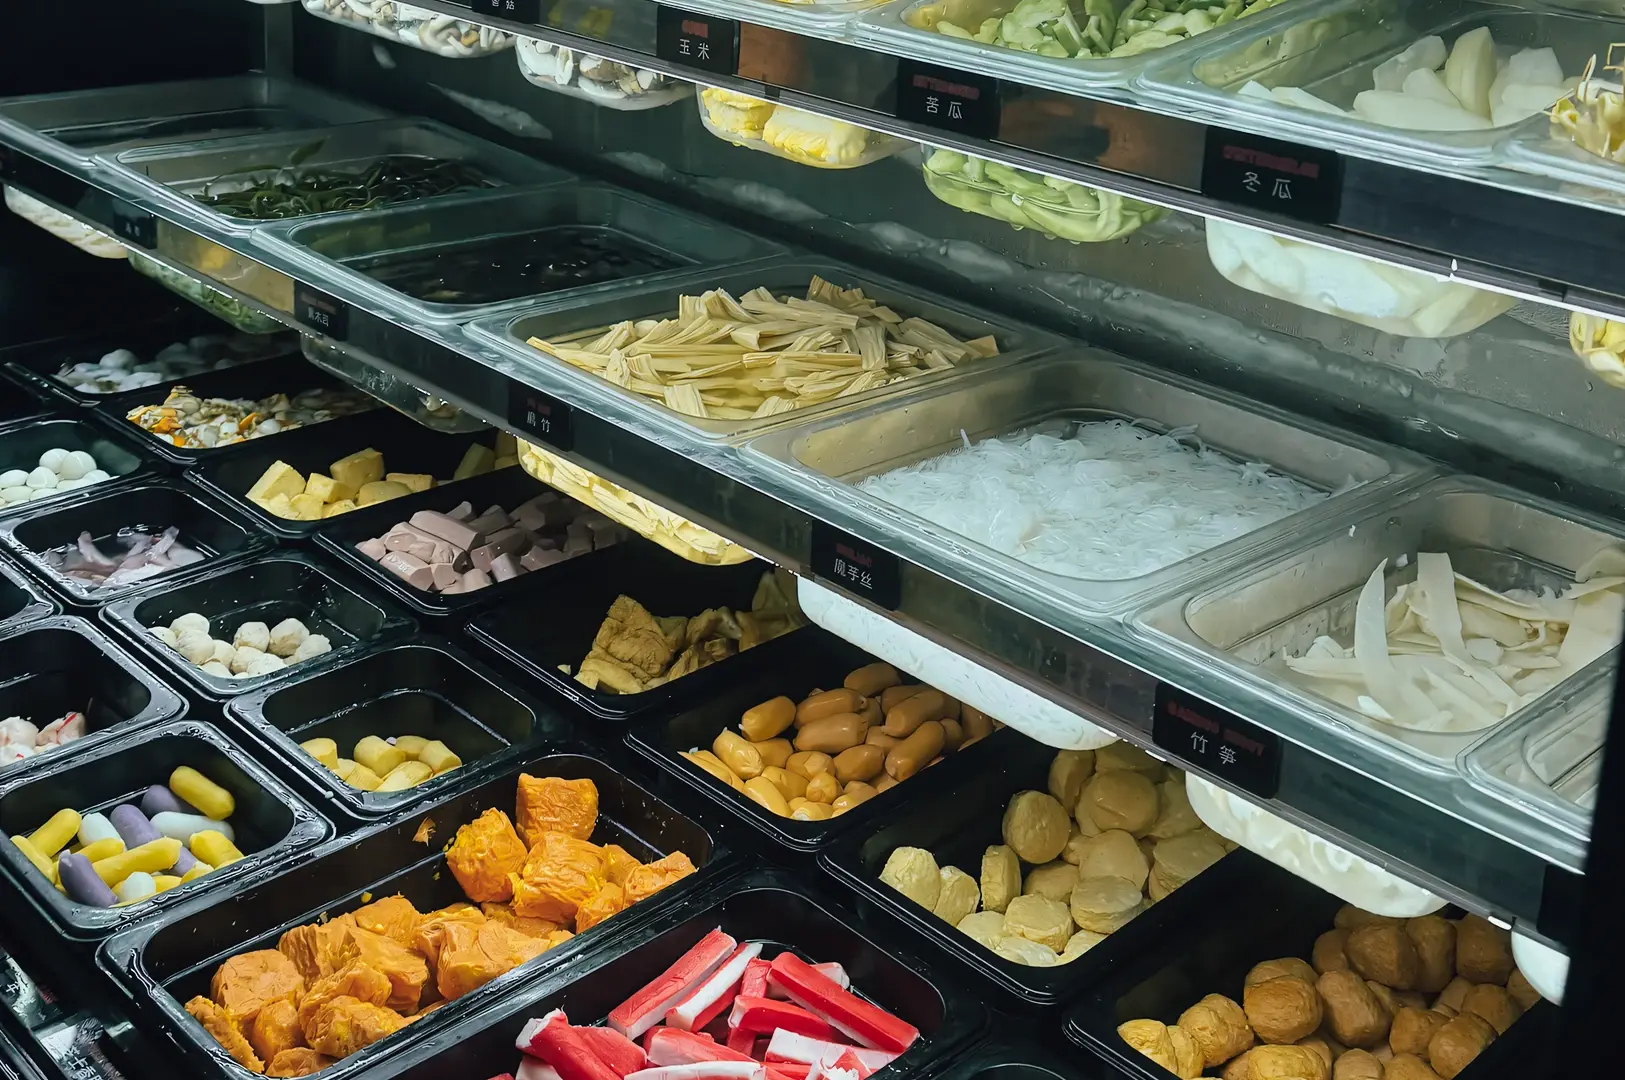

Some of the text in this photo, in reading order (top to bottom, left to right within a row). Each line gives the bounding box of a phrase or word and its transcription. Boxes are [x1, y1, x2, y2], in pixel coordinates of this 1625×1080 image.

[679, 38, 710, 60] 玉米
[926, 96, 962, 119] 苦瓜
[1242, 172, 1292, 199] 冬瓜
[1190, 732, 1236, 765] 竹笋
